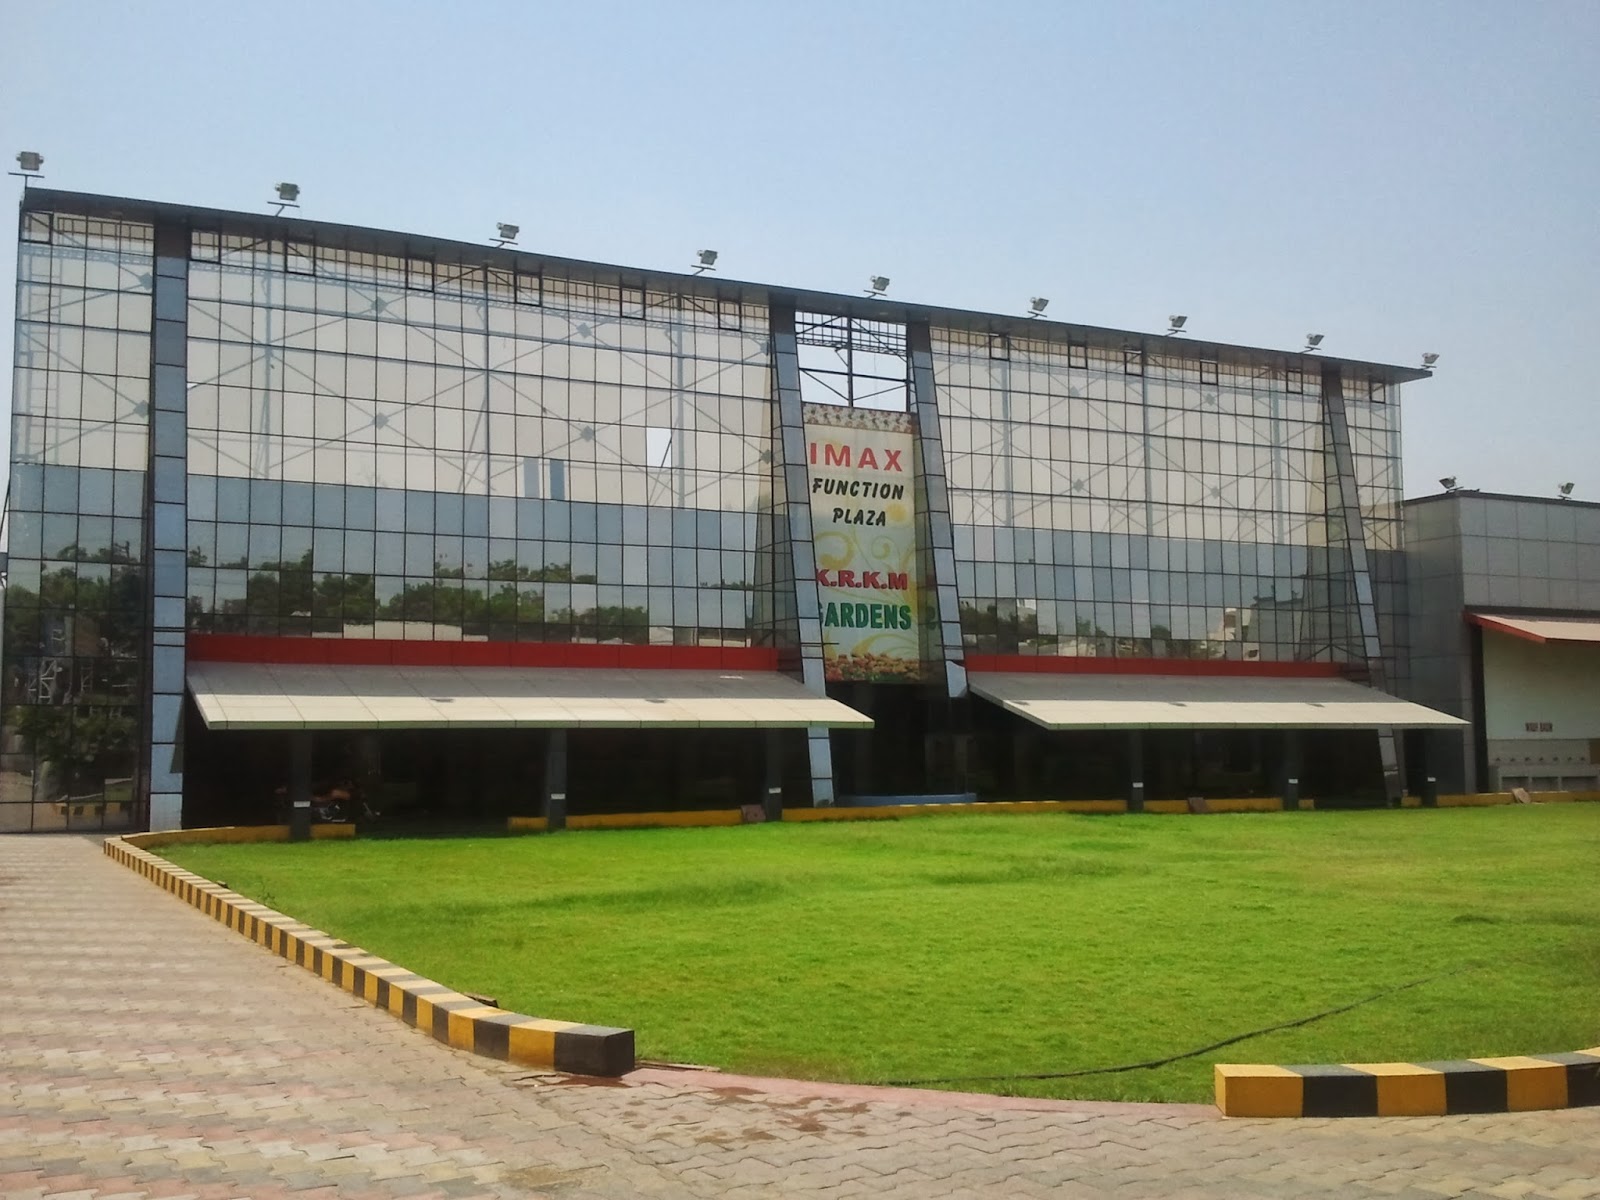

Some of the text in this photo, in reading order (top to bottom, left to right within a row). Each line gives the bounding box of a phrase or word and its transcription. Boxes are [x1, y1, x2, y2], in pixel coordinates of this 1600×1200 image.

[809, 442, 903, 472] IMAX
[812, 478, 904, 500] FUNCTION
[832, 508, 886, 527] PLAZA
[815, 568, 908, 590] K.R.K.M
[820, 602, 911, 630] ARDENS
